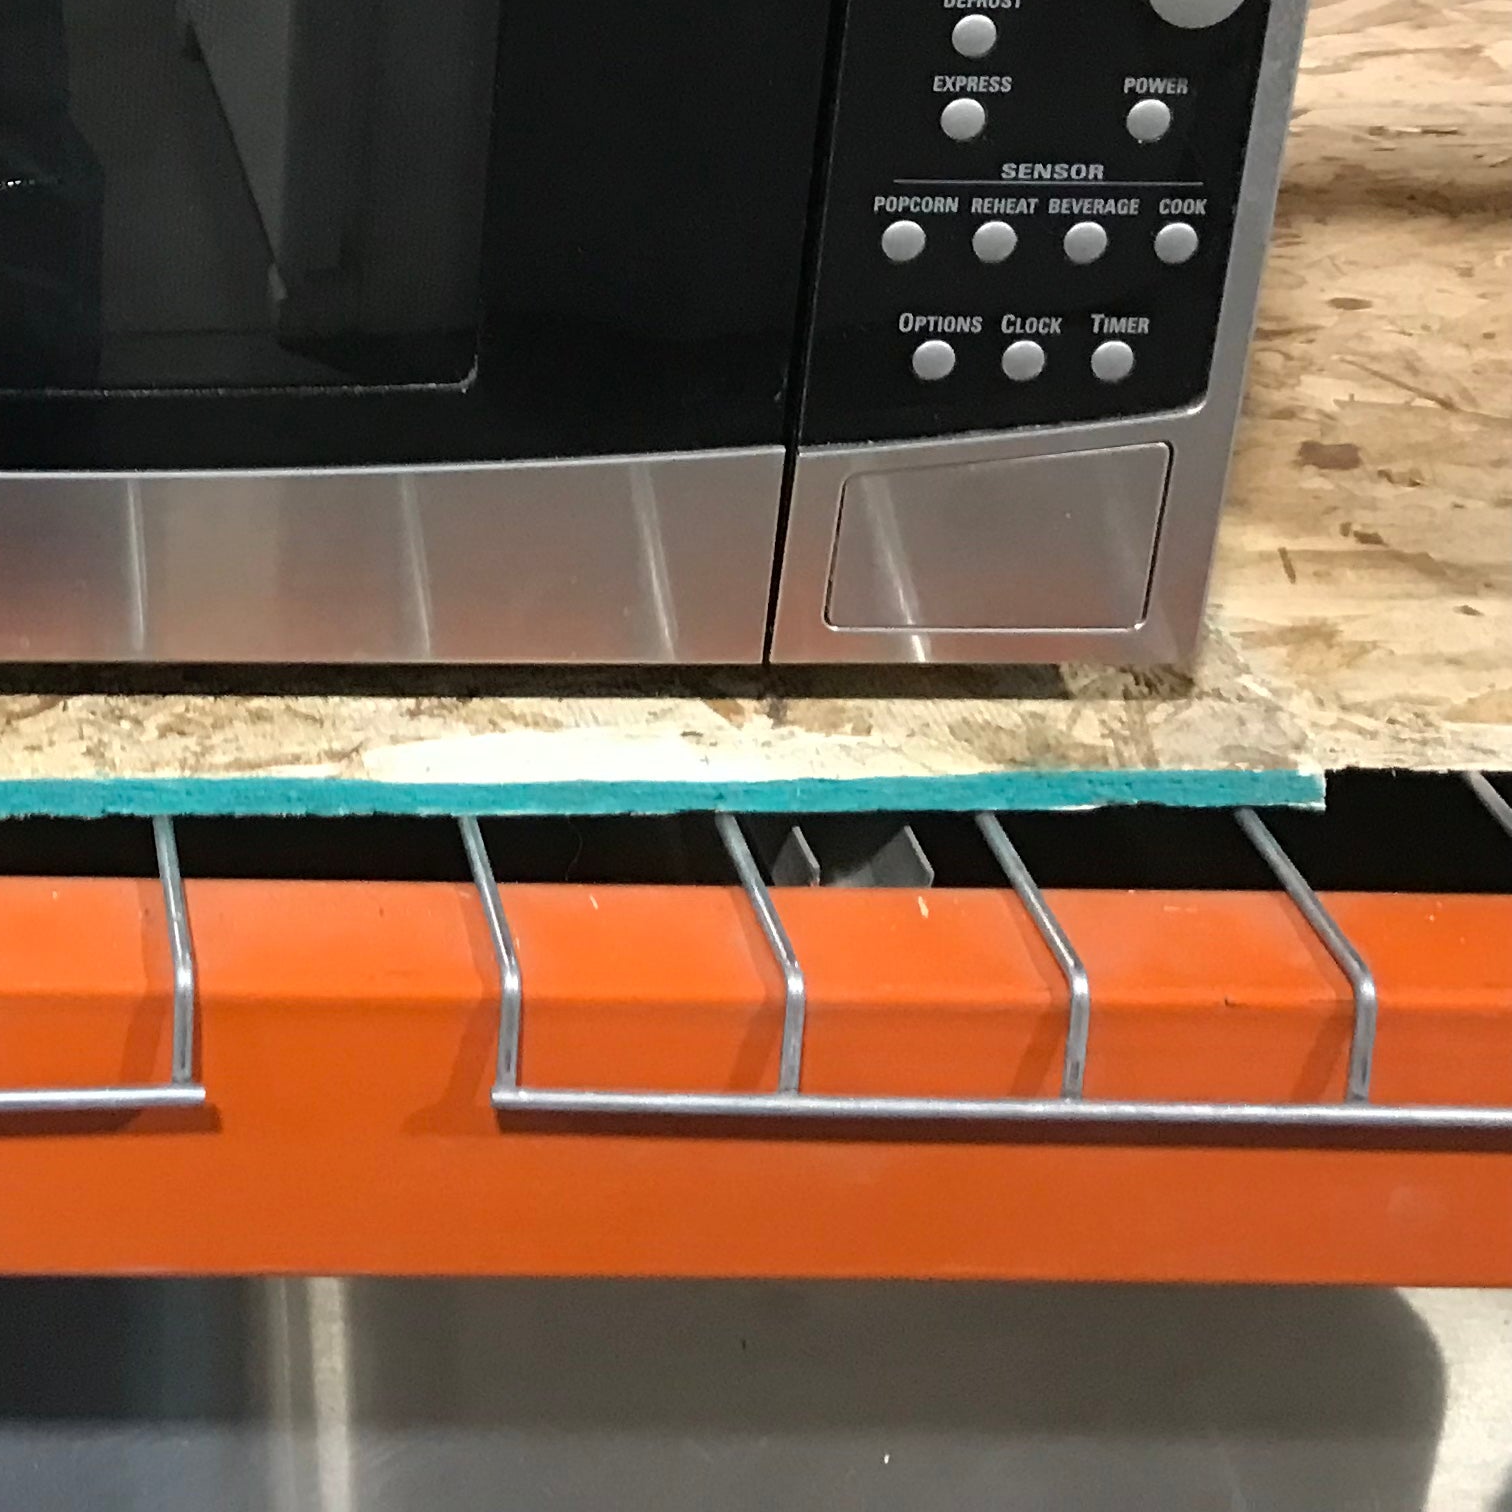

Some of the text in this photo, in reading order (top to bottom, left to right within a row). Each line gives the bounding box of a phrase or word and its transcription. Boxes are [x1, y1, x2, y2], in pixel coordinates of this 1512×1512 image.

[933, 76, 1013, 93] EXPRESS
[1123, 77, 1189, 95] POWER
[1001, 163, 1105, 180] SENSOR
[873, 196, 959, 214] POPCORN
[971, 197, 1038, 215] REHEAT
[1048, 198, 1140, 216] BEVERAGE
[1158, 199, 1207, 216] COOK
[898, 313, 983, 335] OPTIONS
[1000, 313, 1062, 335] CLOCK
[1090, 314, 1150, 335] TIMER
